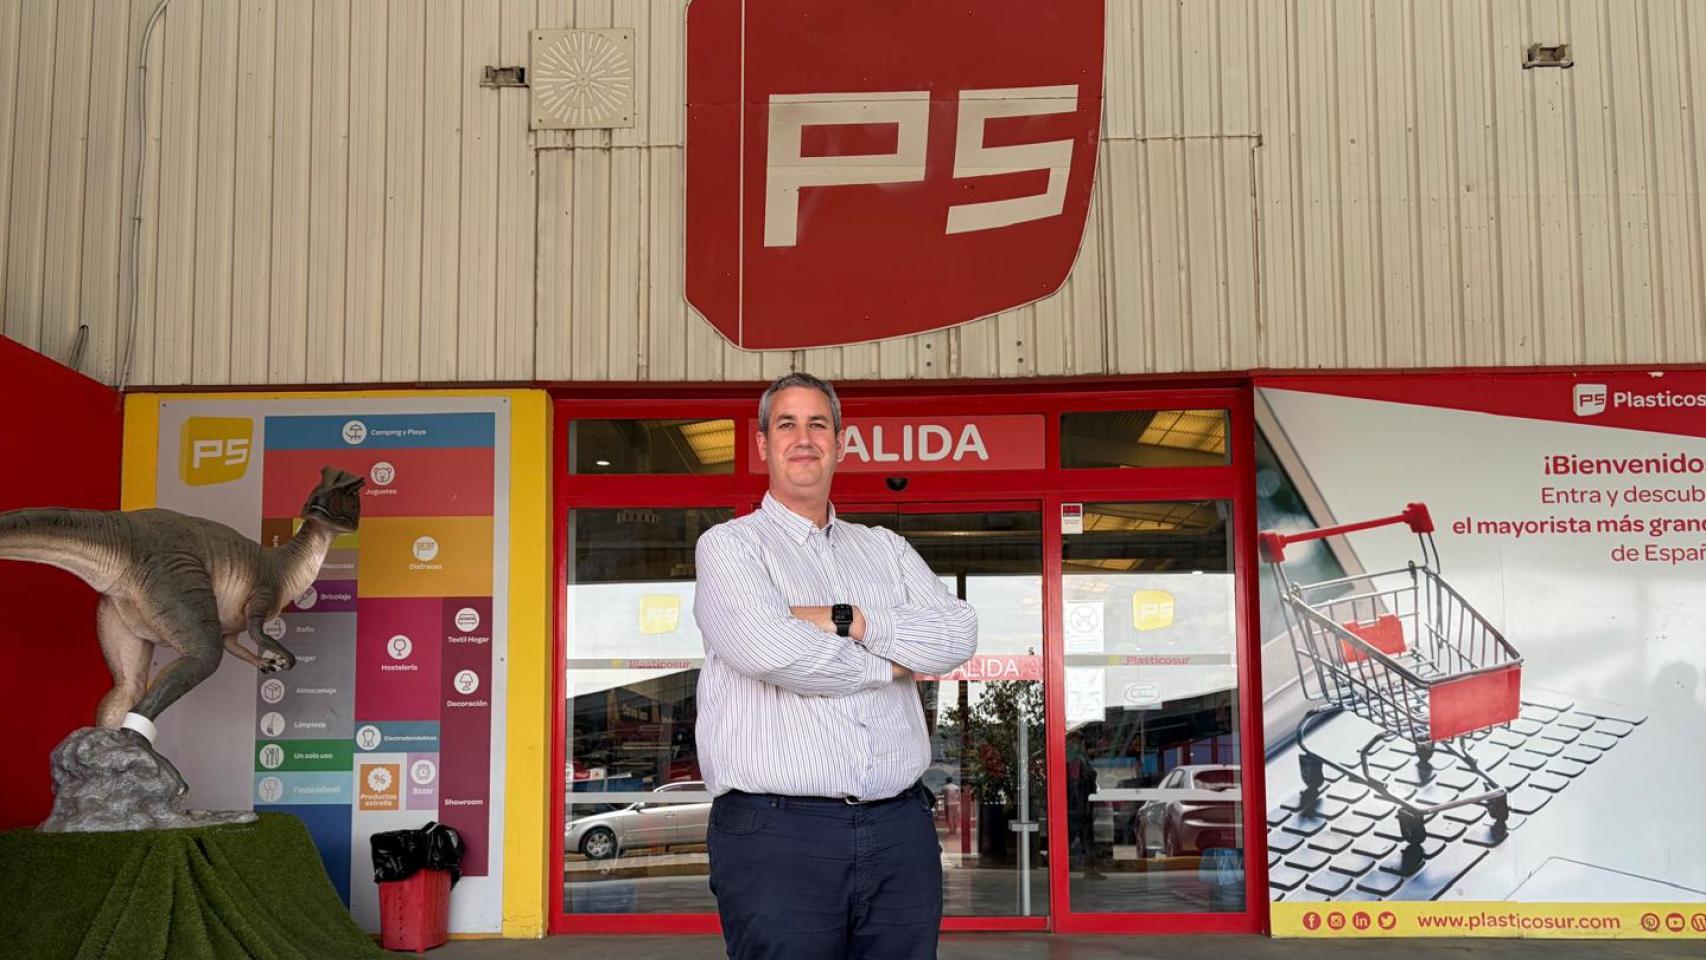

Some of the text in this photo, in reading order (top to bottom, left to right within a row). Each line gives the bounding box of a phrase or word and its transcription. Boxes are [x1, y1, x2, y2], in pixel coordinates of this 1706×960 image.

[764, 84, 1079, 247] PS
[1579, 391, 1706, 407] PS Plasticos
[370, 429, 401, 437] Camping
[408, 428, 426, 436] Playa
[842, 424, 989, 462] ALIDA
[193, 439, 248, 468] PS
[1545, 452, 1706, 475] ¡Bienvenido
[1542, 484, 1706, 507] Entra y descub
[1453, 517, 1471, 534] el
[1477, 516, 1592, 538] mayorista
[1597, 514, 1645, 533] más
[1611, 544, 1639, 562] de
[468, 636, 490, 645] Hogar
[950, 659, 1019, 677] ALIDA
[1125, 655, 1190, 665] Plasticosur
[294, 721, 326, 729] Limpieza
[1417, 912, 1621, 931] www.plasticosur.com
